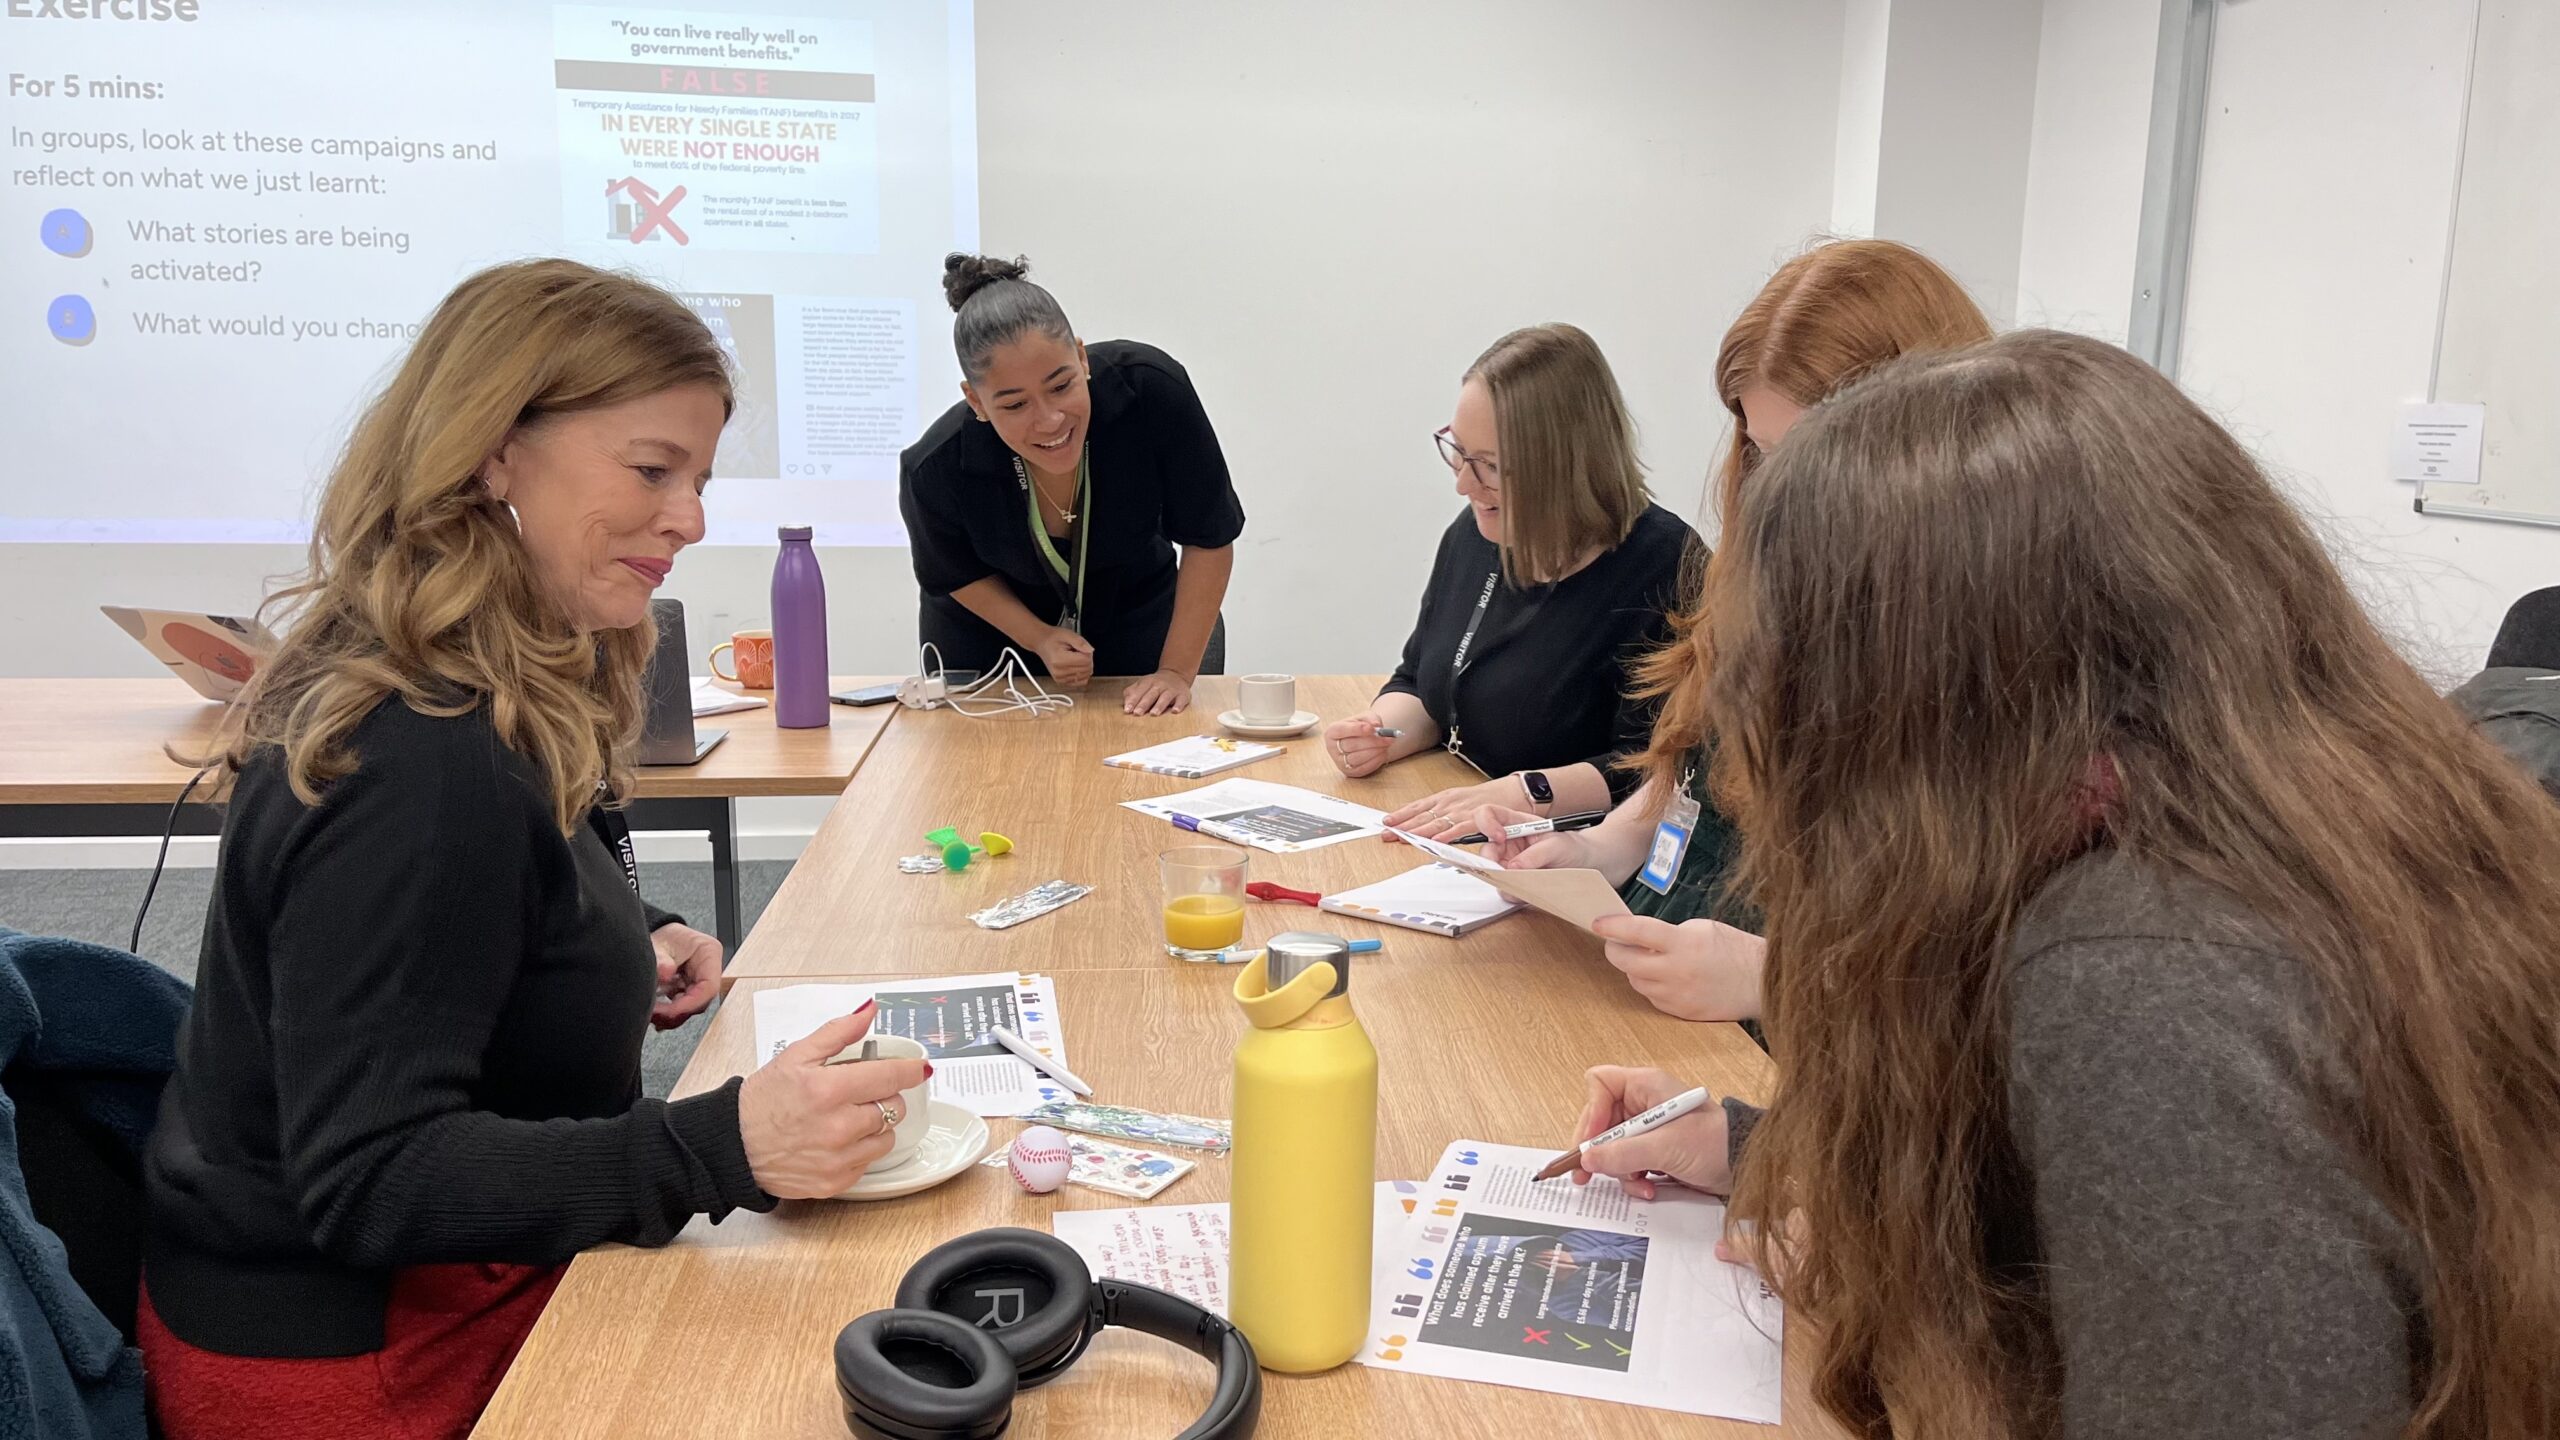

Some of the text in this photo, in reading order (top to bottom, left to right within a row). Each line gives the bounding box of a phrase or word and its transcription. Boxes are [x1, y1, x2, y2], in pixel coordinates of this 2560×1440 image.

[611, 20, 818, 46] "You can live really well on
[630, 43, 800, 61] government benefits."
[9, 73, 164, 99] For 5 mins:
[659, 67, 769, 95] FALSE
[571, 98, 622, 113] Temporary
[625, 101, 673, 113] Assistance
[675, 103, 688, 113] for
[721, 105, 759, 116] Families
[793, 109, 829, 120] benefits
[830, 110, 839, 119] in
[602, 113, 837, 141] IN EVERY SINGLE STATE
[12, 126, 496, 163] In groups, look at these campaigns and
[620, 138, 820, 163] WERE NOT ENOUGH
[14, 165, 386, 196] reflect on what we just learnt:
[633, 160, 643, 168] to
[645, 161, 668, 169] meet
[691, 161, 702, 170] of
[703, 162, 717, 171] the
[719, 162, 751, 172] federal
[753, 164, 788, 175] poverty
[128, 220, 410, 254] What stories are being
[130, 259, 262, 282] activated?
[708, 296, 742, 308] who
[133, 312, 202, 335] What
[209, 315, 285, 336] would
[292, 320, 338, 342] you
[1012, 456, 1028, 490] VISITOR
[1453, 572, 1498, 668] VISITOR VISITOR
[617, 835, 638, 894] VISITO
[1425, 1300, 1445, 1325] What
[1436, 1279, 1453, 1300] does
[1445, 1242, 1466, 1278] someone
[1450, 1237, 1489, 1318] has claimed asylum
[1472, 1235, 1510, 1327] receive after they have
[1497, 1247, 1527, 1319] arrived in the UK?
[974, 1287, 1025, 1328] R
